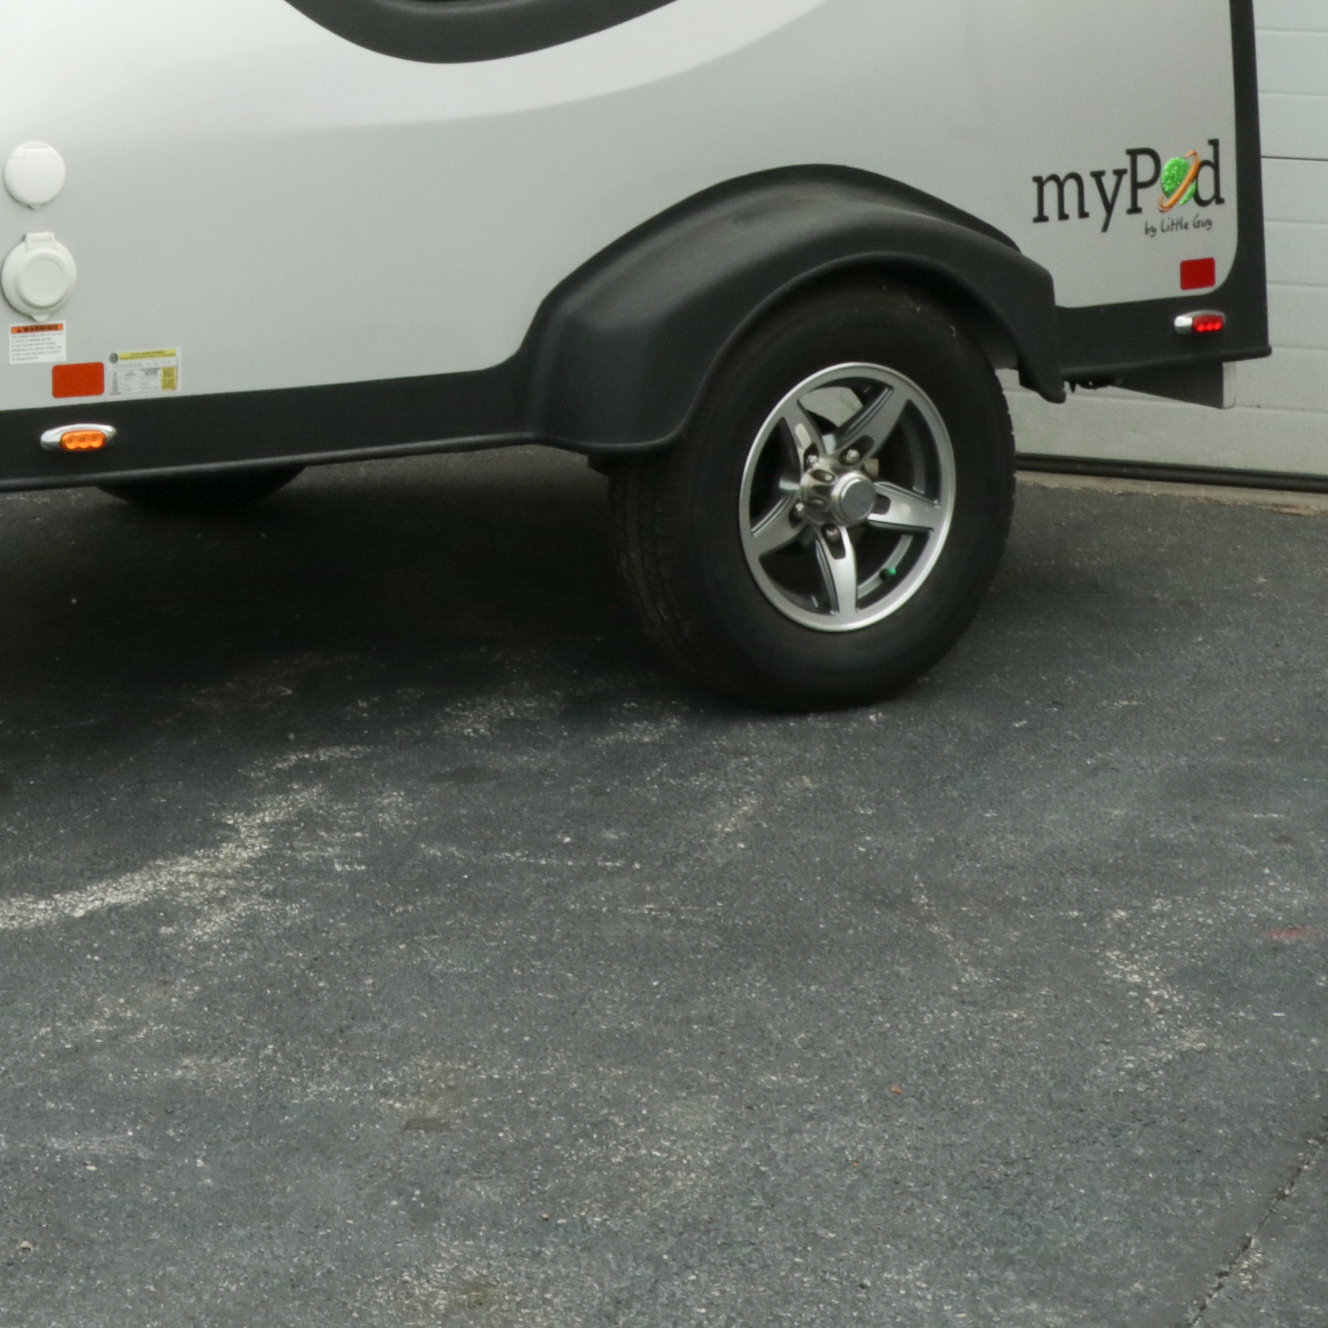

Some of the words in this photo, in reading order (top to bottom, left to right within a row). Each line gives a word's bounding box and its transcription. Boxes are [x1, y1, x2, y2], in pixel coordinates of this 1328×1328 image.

[1144, 220, 1158, 239] by
[1160, 215, 1190, 233] Little
[1192, 213, 1214, 232] Guy
